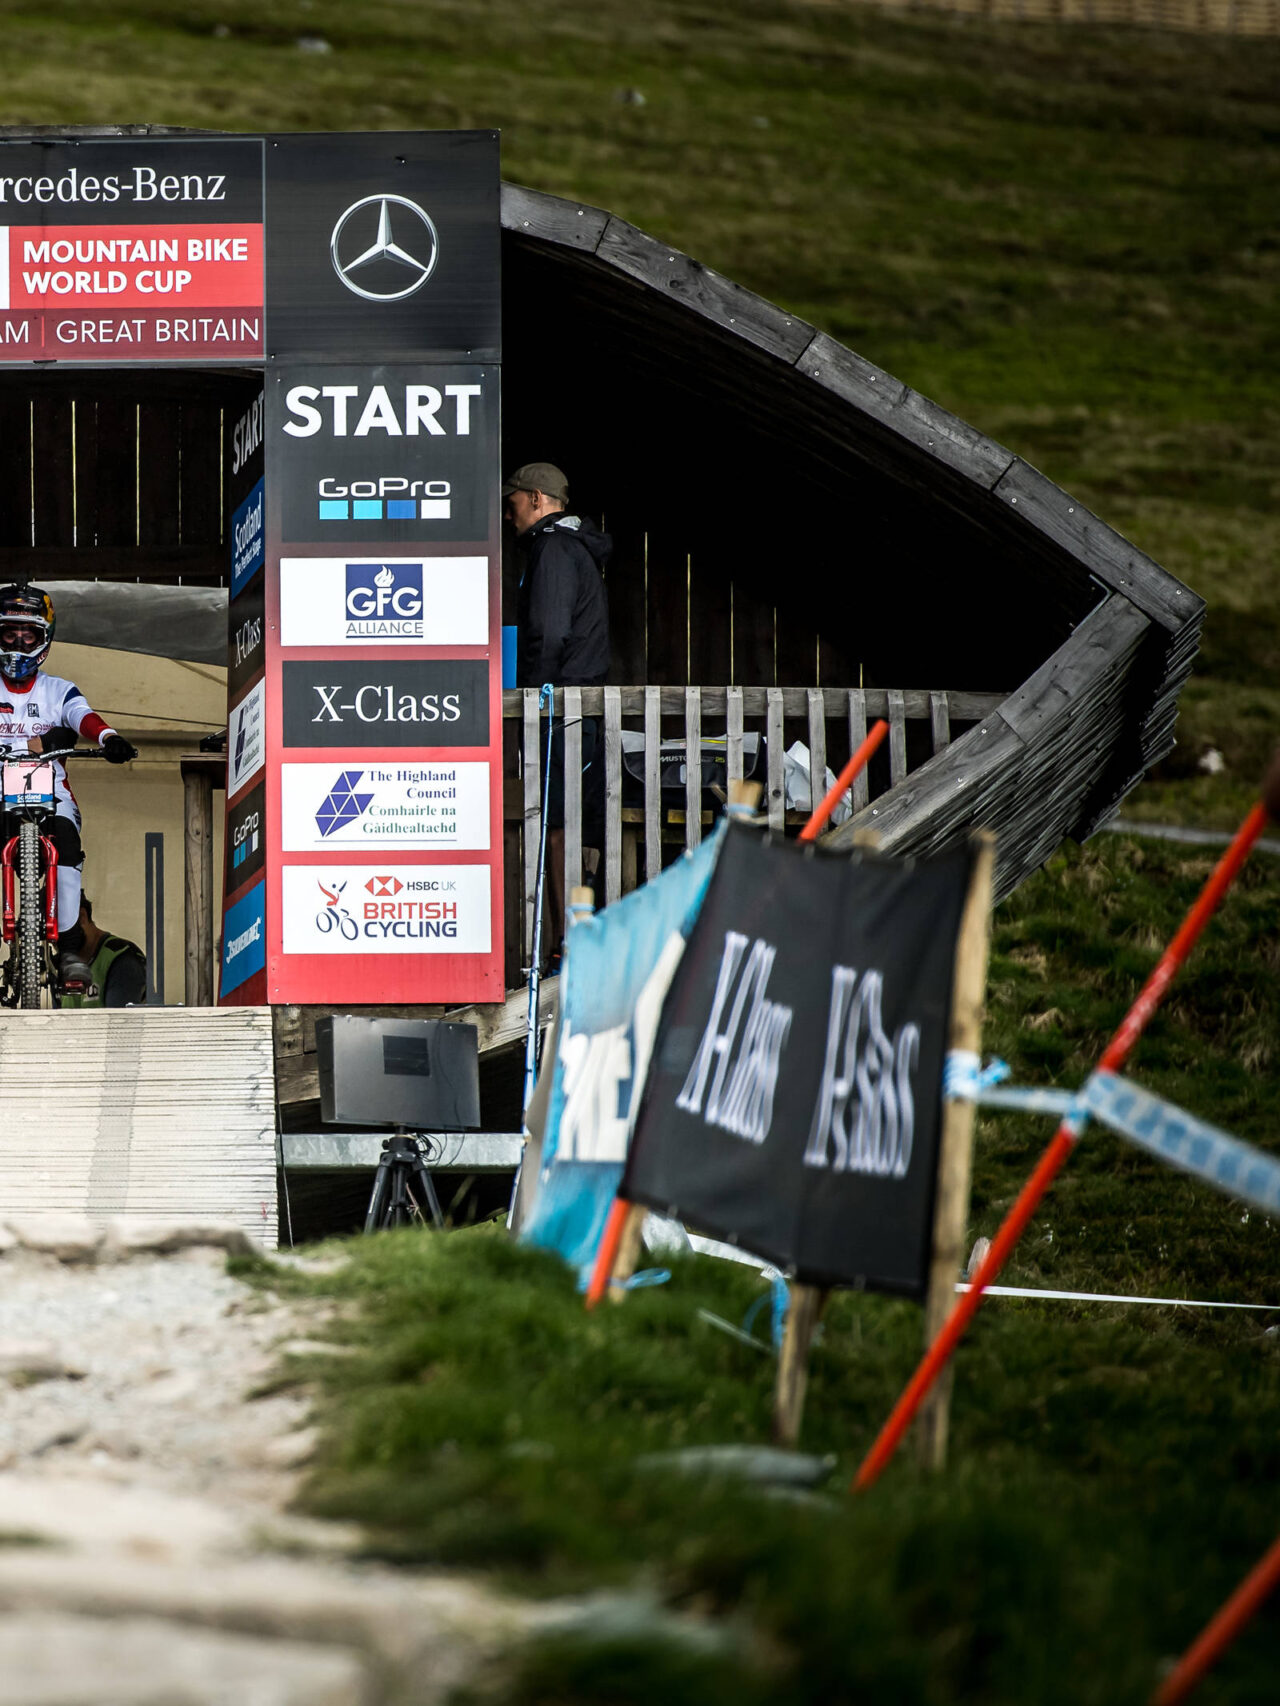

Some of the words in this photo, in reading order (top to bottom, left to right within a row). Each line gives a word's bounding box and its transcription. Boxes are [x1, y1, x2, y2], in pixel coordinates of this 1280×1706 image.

[23, 240, 182, 264] MOUNTAIN
[187, 237, 248, 262] BIKE
[23, 270, 129, 294] WORLD
[134, 270, 192, 294] CUP
[55, 319, 146, 343] GREAT
[156, 317, 260, 342] BRITAIN
[282, 385, 481, 437] START
[233, 389, 264, 476] START
[319, 477, 451, 497] GoPro
[346, 587, 422, 617] GFG
[346, 619, 424, 634] ALLIANCE
[311, 685, 461, 722] X-Class
[23, 772, 32, 790] 1
[368, 770, 393, 782] The
[397, 770, 456, 784] Highland
[406, 787, 456, 799] Council
[368, 805, 437, 816] Comhairle
[441, 807, 456, 816] na
[407, 881, 439, 891] HSBC
[441, 881, 457, 891] UK
[363, 902, 458, 920] BRITISH
[363, 921, 457, 938] CYCLING
